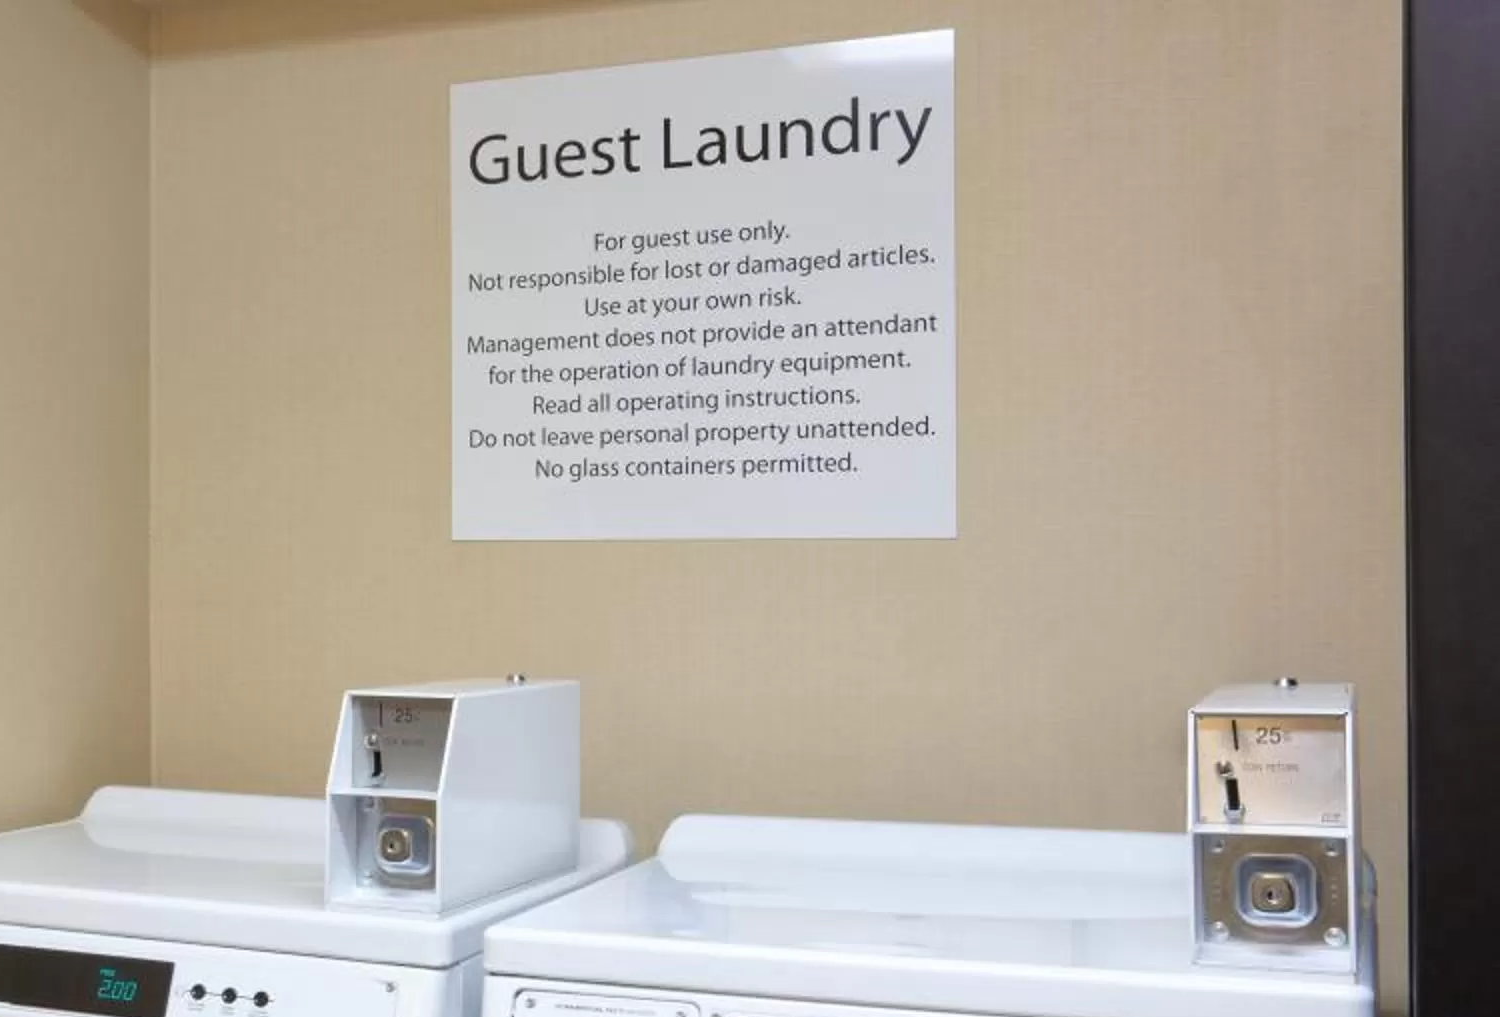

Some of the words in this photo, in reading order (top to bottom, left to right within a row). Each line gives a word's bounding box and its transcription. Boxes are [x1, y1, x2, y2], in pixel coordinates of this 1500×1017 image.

[469, 127, 641, 185] Guest
[662, 95, 932, 169] Laundry
[593, 232, 626, 252] For
[631, 228, 690, 254] guest
[696, 227, 732, 245] use
[737, 219, 790, 244] only.
[468, 273, 504, 292] Not
[508, 263, 625, 292] responsible
[629, 260, 659, 282] for
[664, 259, 702, 279] lost
[707, 260, 730, 277] or
[735, 247, 841, 277] damaged
[847, 243, 935, 268] articles.
[584, 296, 621, 316] Use
[626, 296, 647, 314] at
[651, 295, 700, 318] your
[704, 292, 752, 310] own
[758, 284, 801, 307] risk.
[467, 331, 600, 356] Management
[604, 327, 654, 348] does
[660, 327, 696, 344] not
[702, 319, 785, 348] provide
[790, 322, 818, 339] an
[823, 312, 937, 336] attendant
[488, 364, 516, 384] for
[520, 363, 554, 383] the
[558, 359, 659, 386] operation
[664, 355, 687, 377] of
[691, 353, 774, 379] laundry
[779, 349, 911, 377] equipment.
[532, 393, 581, 414] Read
[586, 392, 610, 412] all
[615, 390, 718, 416] operating
[725, 385, 860, 408] instructions.
[469, 428, 497, 448] Do
[502, 429, 536, 447] not
[541, 427, 594, 446] leave
[599, 422, 688, 448] personal
[694, 422, 790, 446] property
[796, 415, 935, 439] unattended.
[535, 459, 564, 478] No
[568, 457, 619, 482] glass
[624, 455, 735, 477] containers
[741, 451, 857, 478] permitted.
[394, 707, 420, 725] 25
[1255, 727, 1291, 745] 25
